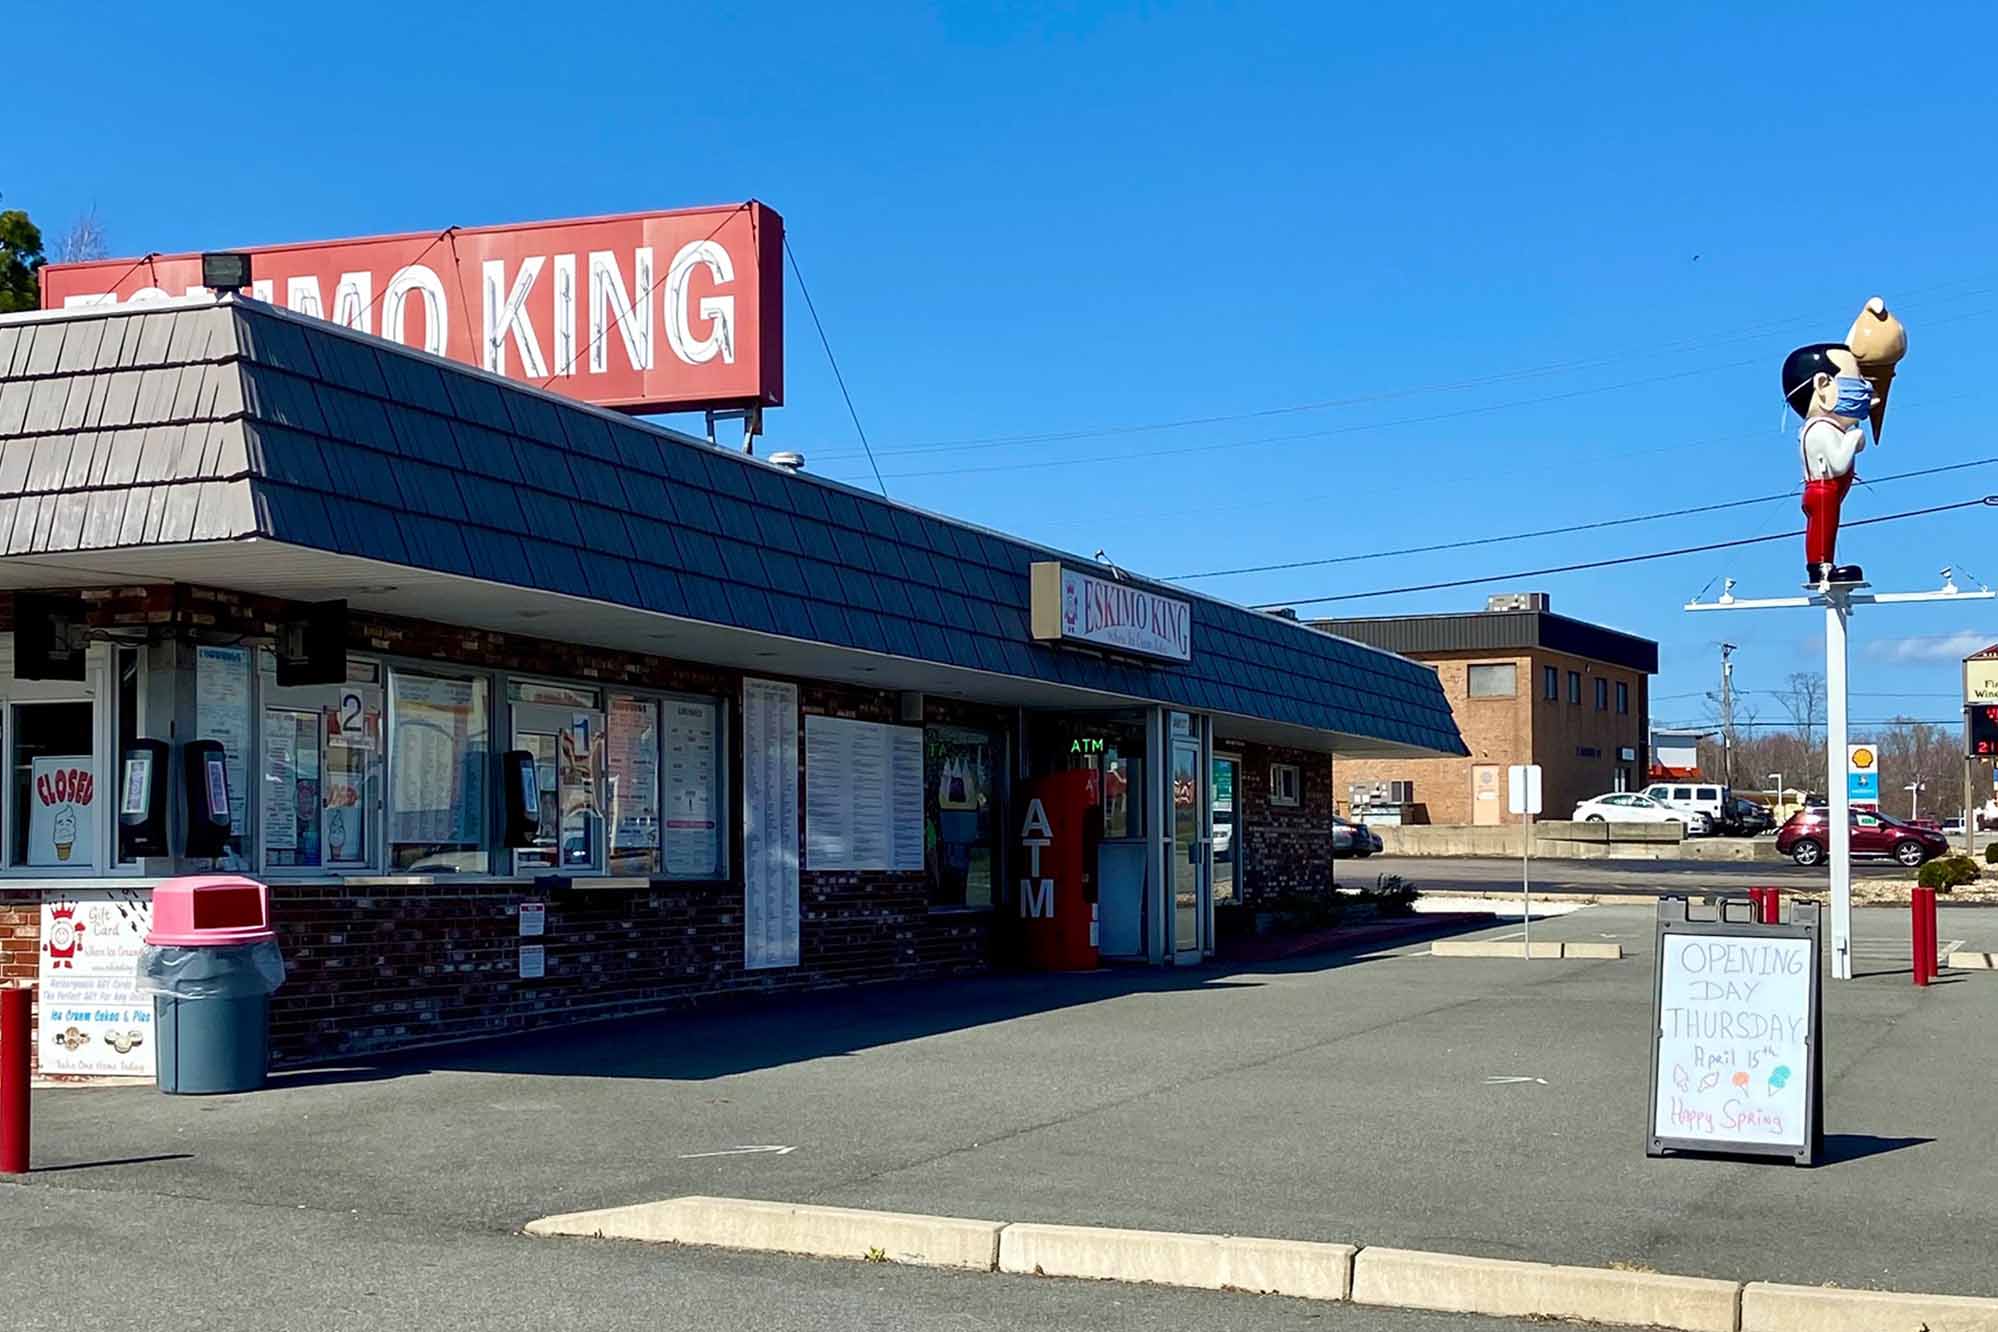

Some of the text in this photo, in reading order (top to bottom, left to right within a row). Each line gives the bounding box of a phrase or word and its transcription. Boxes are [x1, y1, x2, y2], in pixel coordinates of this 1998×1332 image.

[482, 239, 735, 379] KING
[1084, 580, 1147, 634] ESKIMO
[1151, 597, 1188, 656] KING
[343, 693, 362, 732] 2
[1070, 738, 1104, 753] ATM
[36, 768, 94, 807] CLOSED
[1020, 798, 1055, 919] ATM
[89, 906, 112, 923] Gift
[94, 922, 120, 936] Card
[1681, 943, 1804, 975] OPENING
[1690, 980, 1760, 1001] DAY
[51, 1010, 62, 1021] Ice
[65, 1009, 91, 1021] Cream
[95, 1010, 119, 1022] Cakes
[1665, 1008, 1804, 1044] THURSDAY
[1694, 1044, 1779, 1069] April 15th
[1671, 1096, 1784, 1135] Happy Spring
